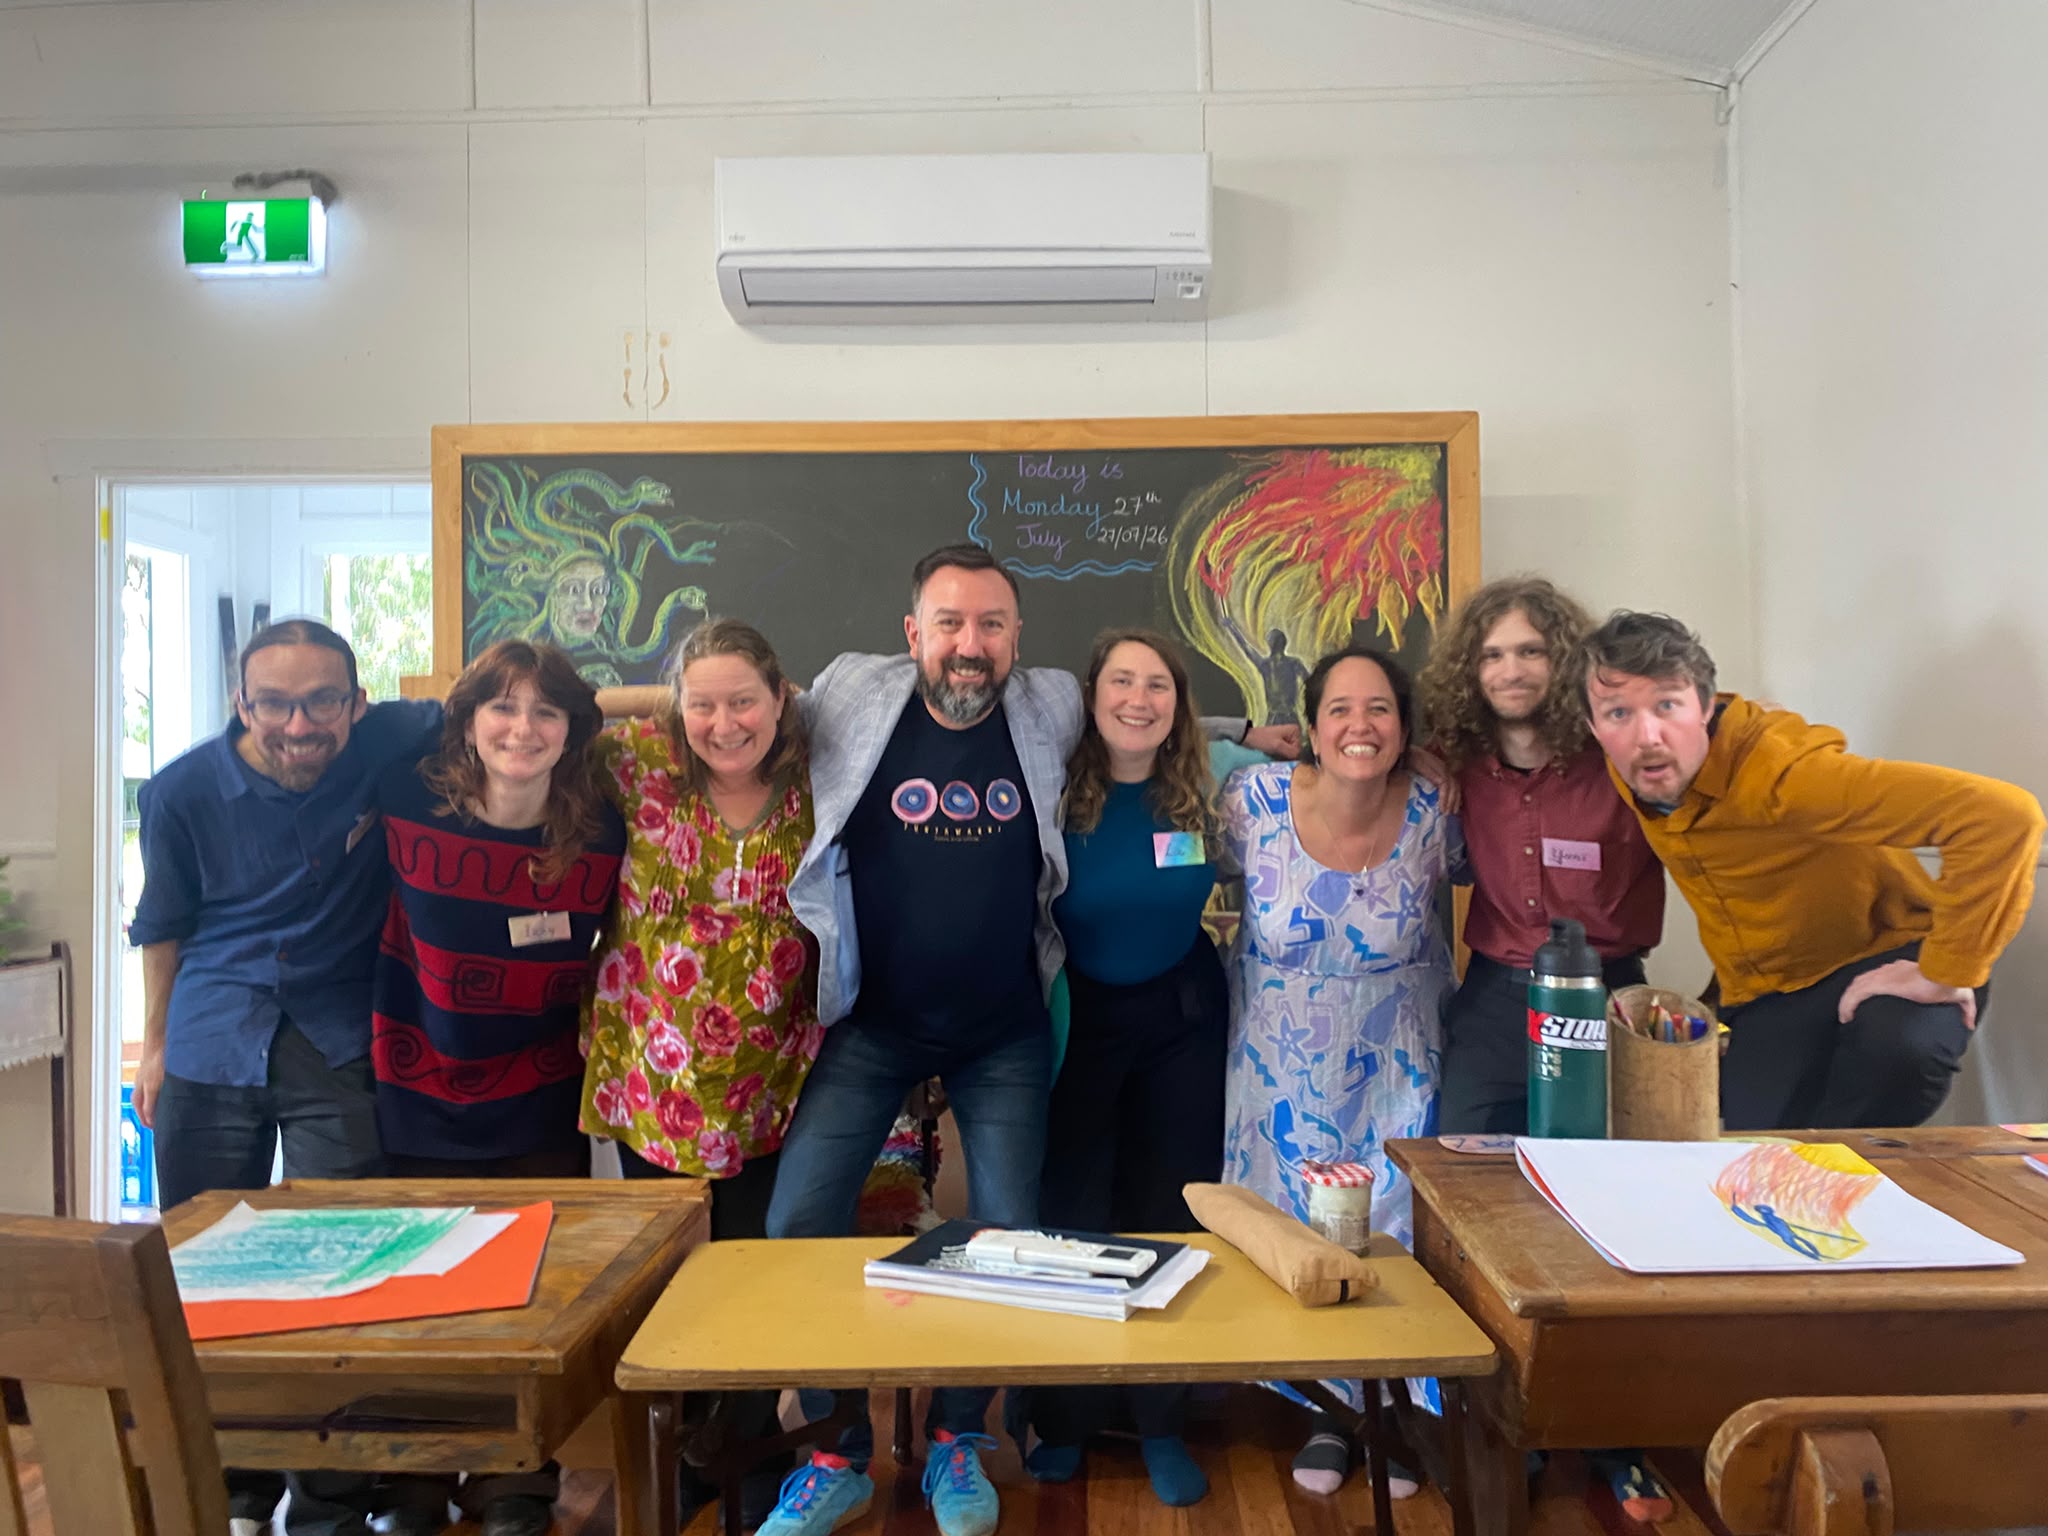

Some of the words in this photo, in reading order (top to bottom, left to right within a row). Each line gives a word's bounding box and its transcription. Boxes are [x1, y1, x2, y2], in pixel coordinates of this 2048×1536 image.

[1014, 454, 1089, 494] Today
[1100, 456, 1125, 480] is
[1002, 487, 1110, 540] Monday
[1015, 522, 1070, 561] July
[1097, 525, 1169, 550] 27/07/26
